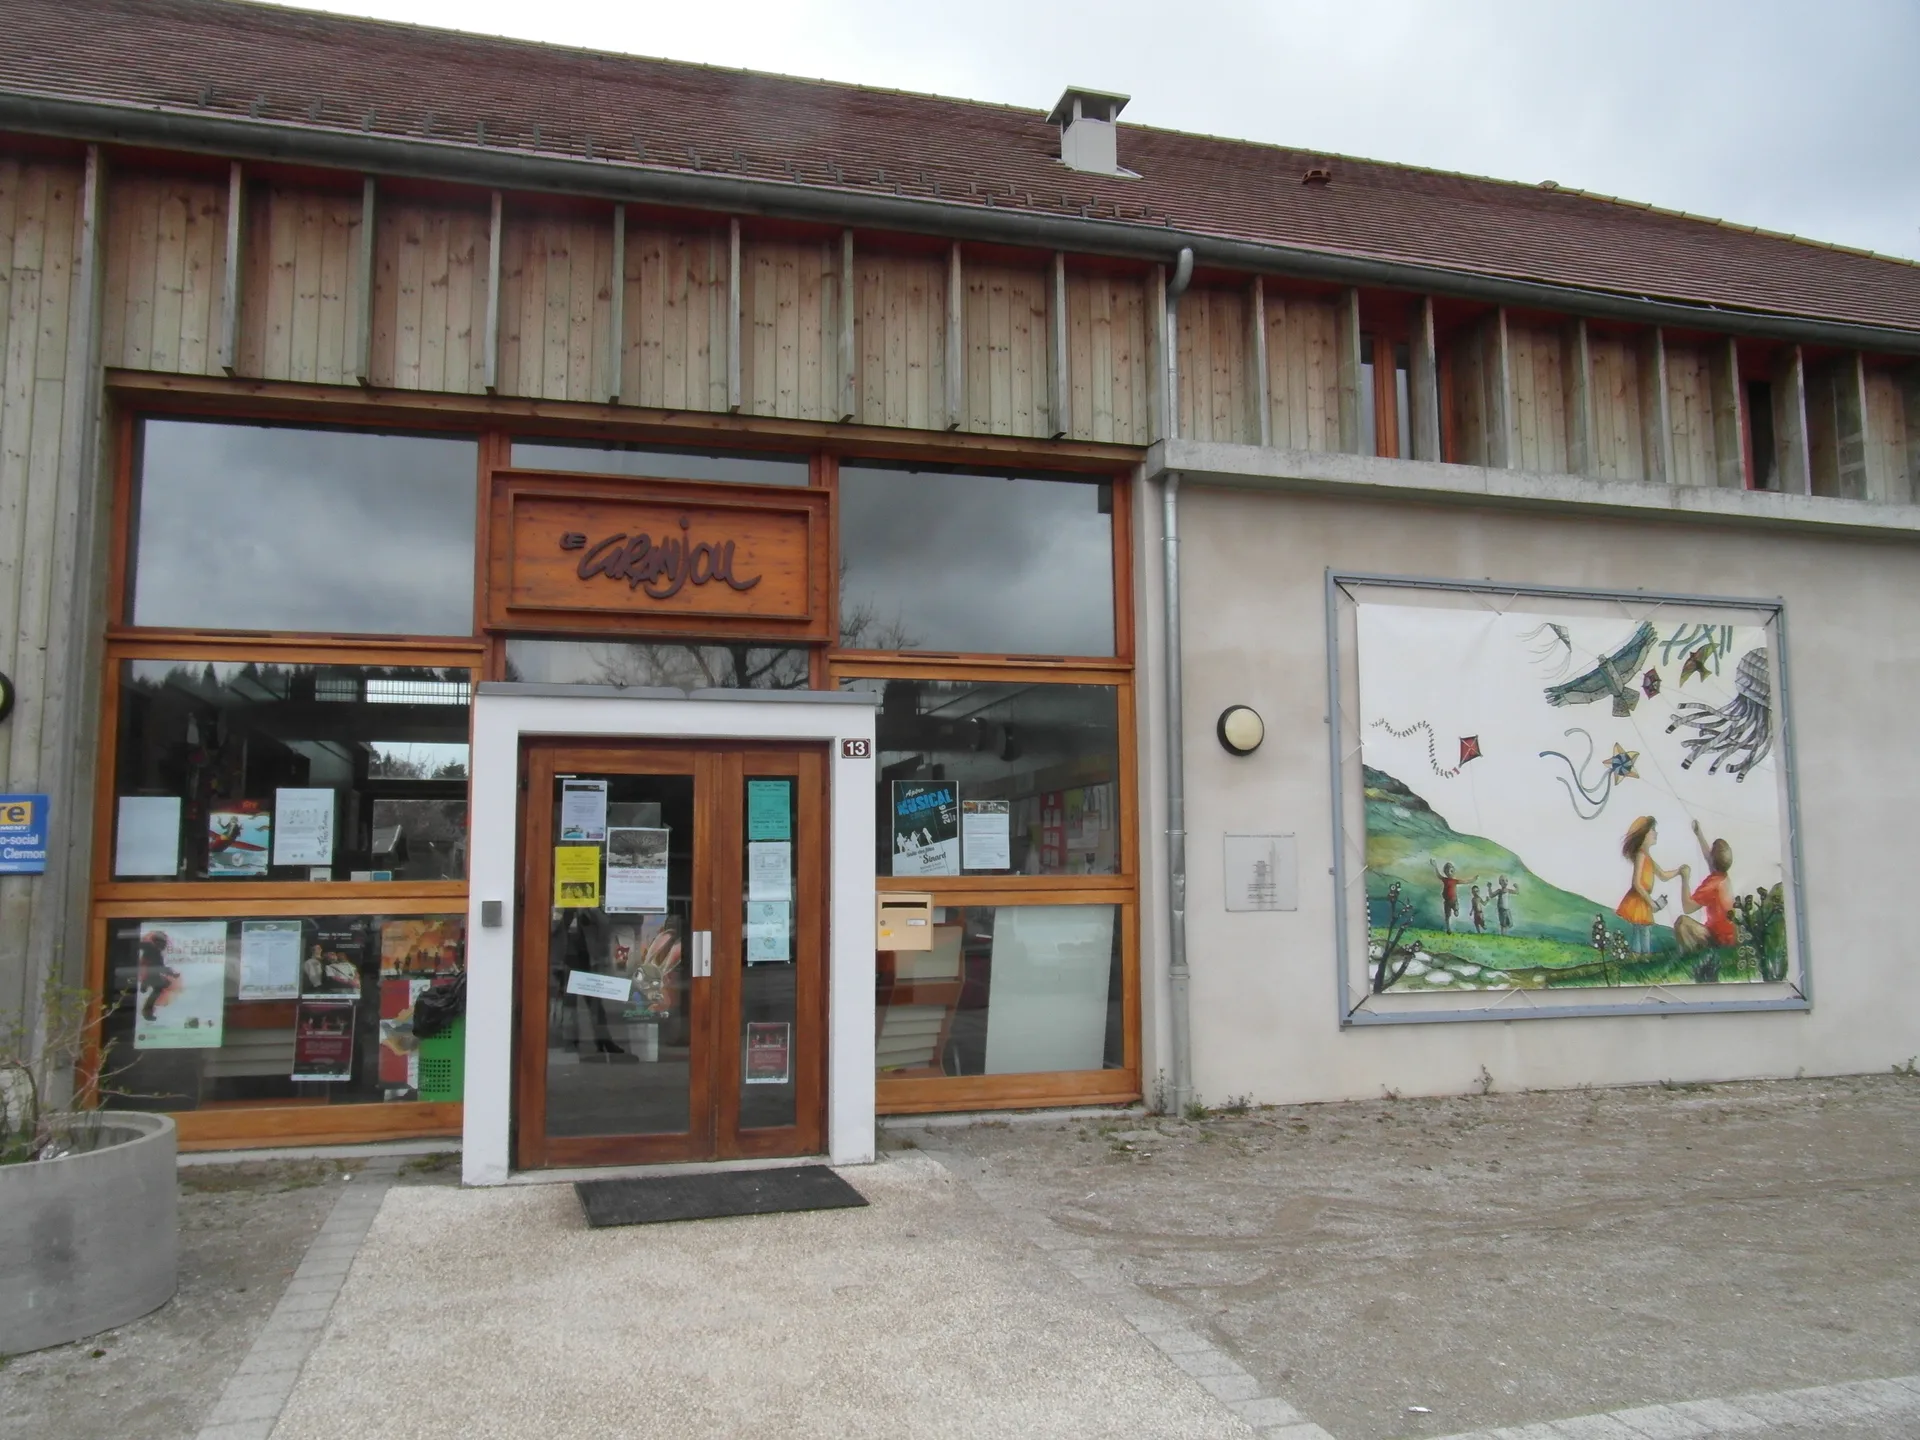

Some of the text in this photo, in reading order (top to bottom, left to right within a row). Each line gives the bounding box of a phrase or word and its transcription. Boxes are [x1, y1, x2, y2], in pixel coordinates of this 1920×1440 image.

[846, 741, 866, 756] 13
[896, 788, 953, 815] MUSICAL
[938, 804, 951, 825] 2016
[923, 852, 947, 865] Sinard
